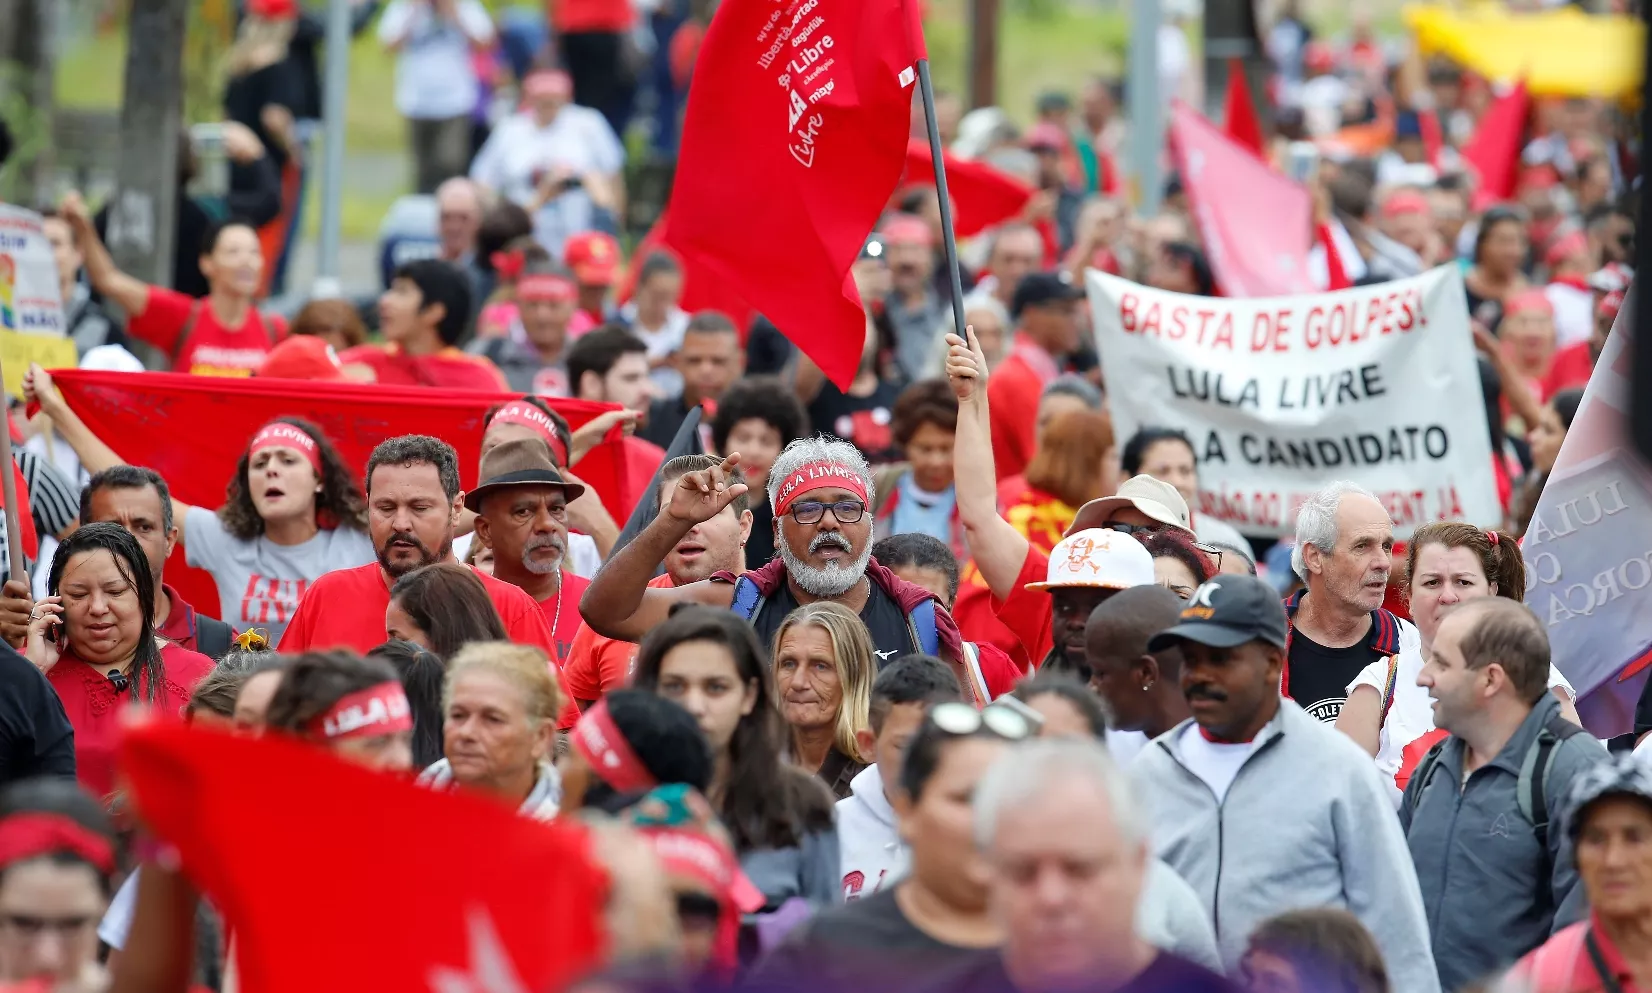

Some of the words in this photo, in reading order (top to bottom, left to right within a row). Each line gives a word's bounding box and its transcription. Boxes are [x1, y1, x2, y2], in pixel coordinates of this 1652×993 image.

[791, 34, 834, 74] Libre
[788, 88, 808, 134] LA
[1119, 291, 1235, 351] BASTA
[1250, 308, 1291, 353] DE
[1303, 288, 1429, 351] GOLPES!
[1166, 364, 1260, 409] LULA
[1276, 362, 1387, 409] LIVRE
[273, 427, 315, 451] LIVRE
[1239, 424, 1451, 468] CANDIDATO
[808, 465, 854, 481] LIVRE
[1310, 703, 1345, 720] COLET
